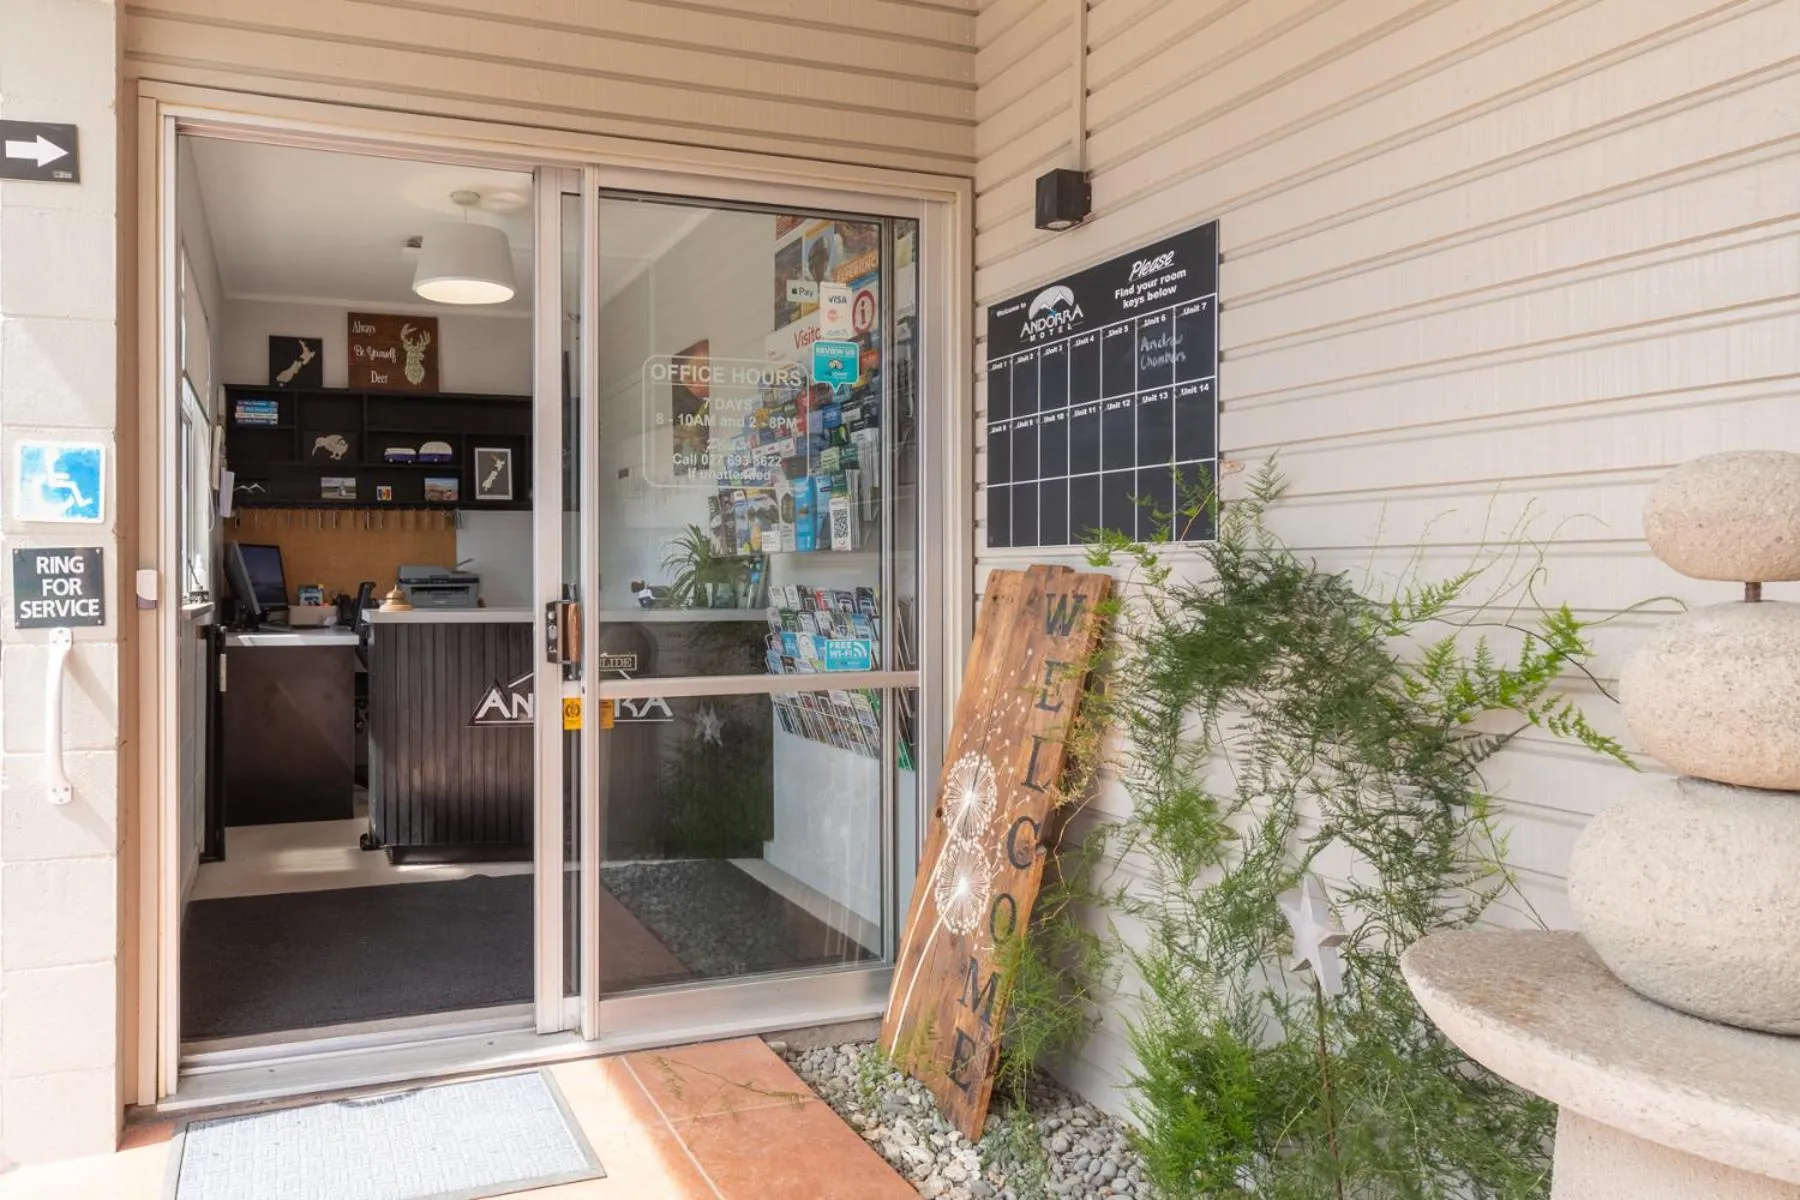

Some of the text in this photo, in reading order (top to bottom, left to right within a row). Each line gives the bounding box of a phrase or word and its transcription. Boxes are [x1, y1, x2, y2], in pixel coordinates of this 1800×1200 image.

[1128, 250, 1176, 282] Please
[1114, 270, 1187, 299] Find your room
[828, 295, 847, 304] VISA
[1122, 284, 1177, 309] keys below
[1183, 305, 1200, 315] Unit
[1020, 303, 1084, 338] ANDORRA
[1143, 316, 1160, 326] Unit
[1029, 323, 1072, 342] MOTEL
[370, 370, 389, 383] Deer
[650, 363, 802, 387] OFFICE HOURS
[1181, 385, 1198, 395] Unit
[703, 396, 752, 411] 7 DAYS
[1106, 402, 1121, 410] Unit
[1142, 394, 1158, 403] Unit
[655, 412, 665, 426] 8
[677, 413, 716, 427] 10AM
[719, 414, 745, 428] and
[749, 416, 757, 429] 2
[768, 418, 798, 431] 8PM
[672, 452, 698, 466] Call
[36, 556, 85, 574] RING
[42, 578, 83, 596] FOR
[19, 598, 100, 618] SERVICE
[829, 641, 852, 649] FREE
[600, 655, 633, 669] LIDE
